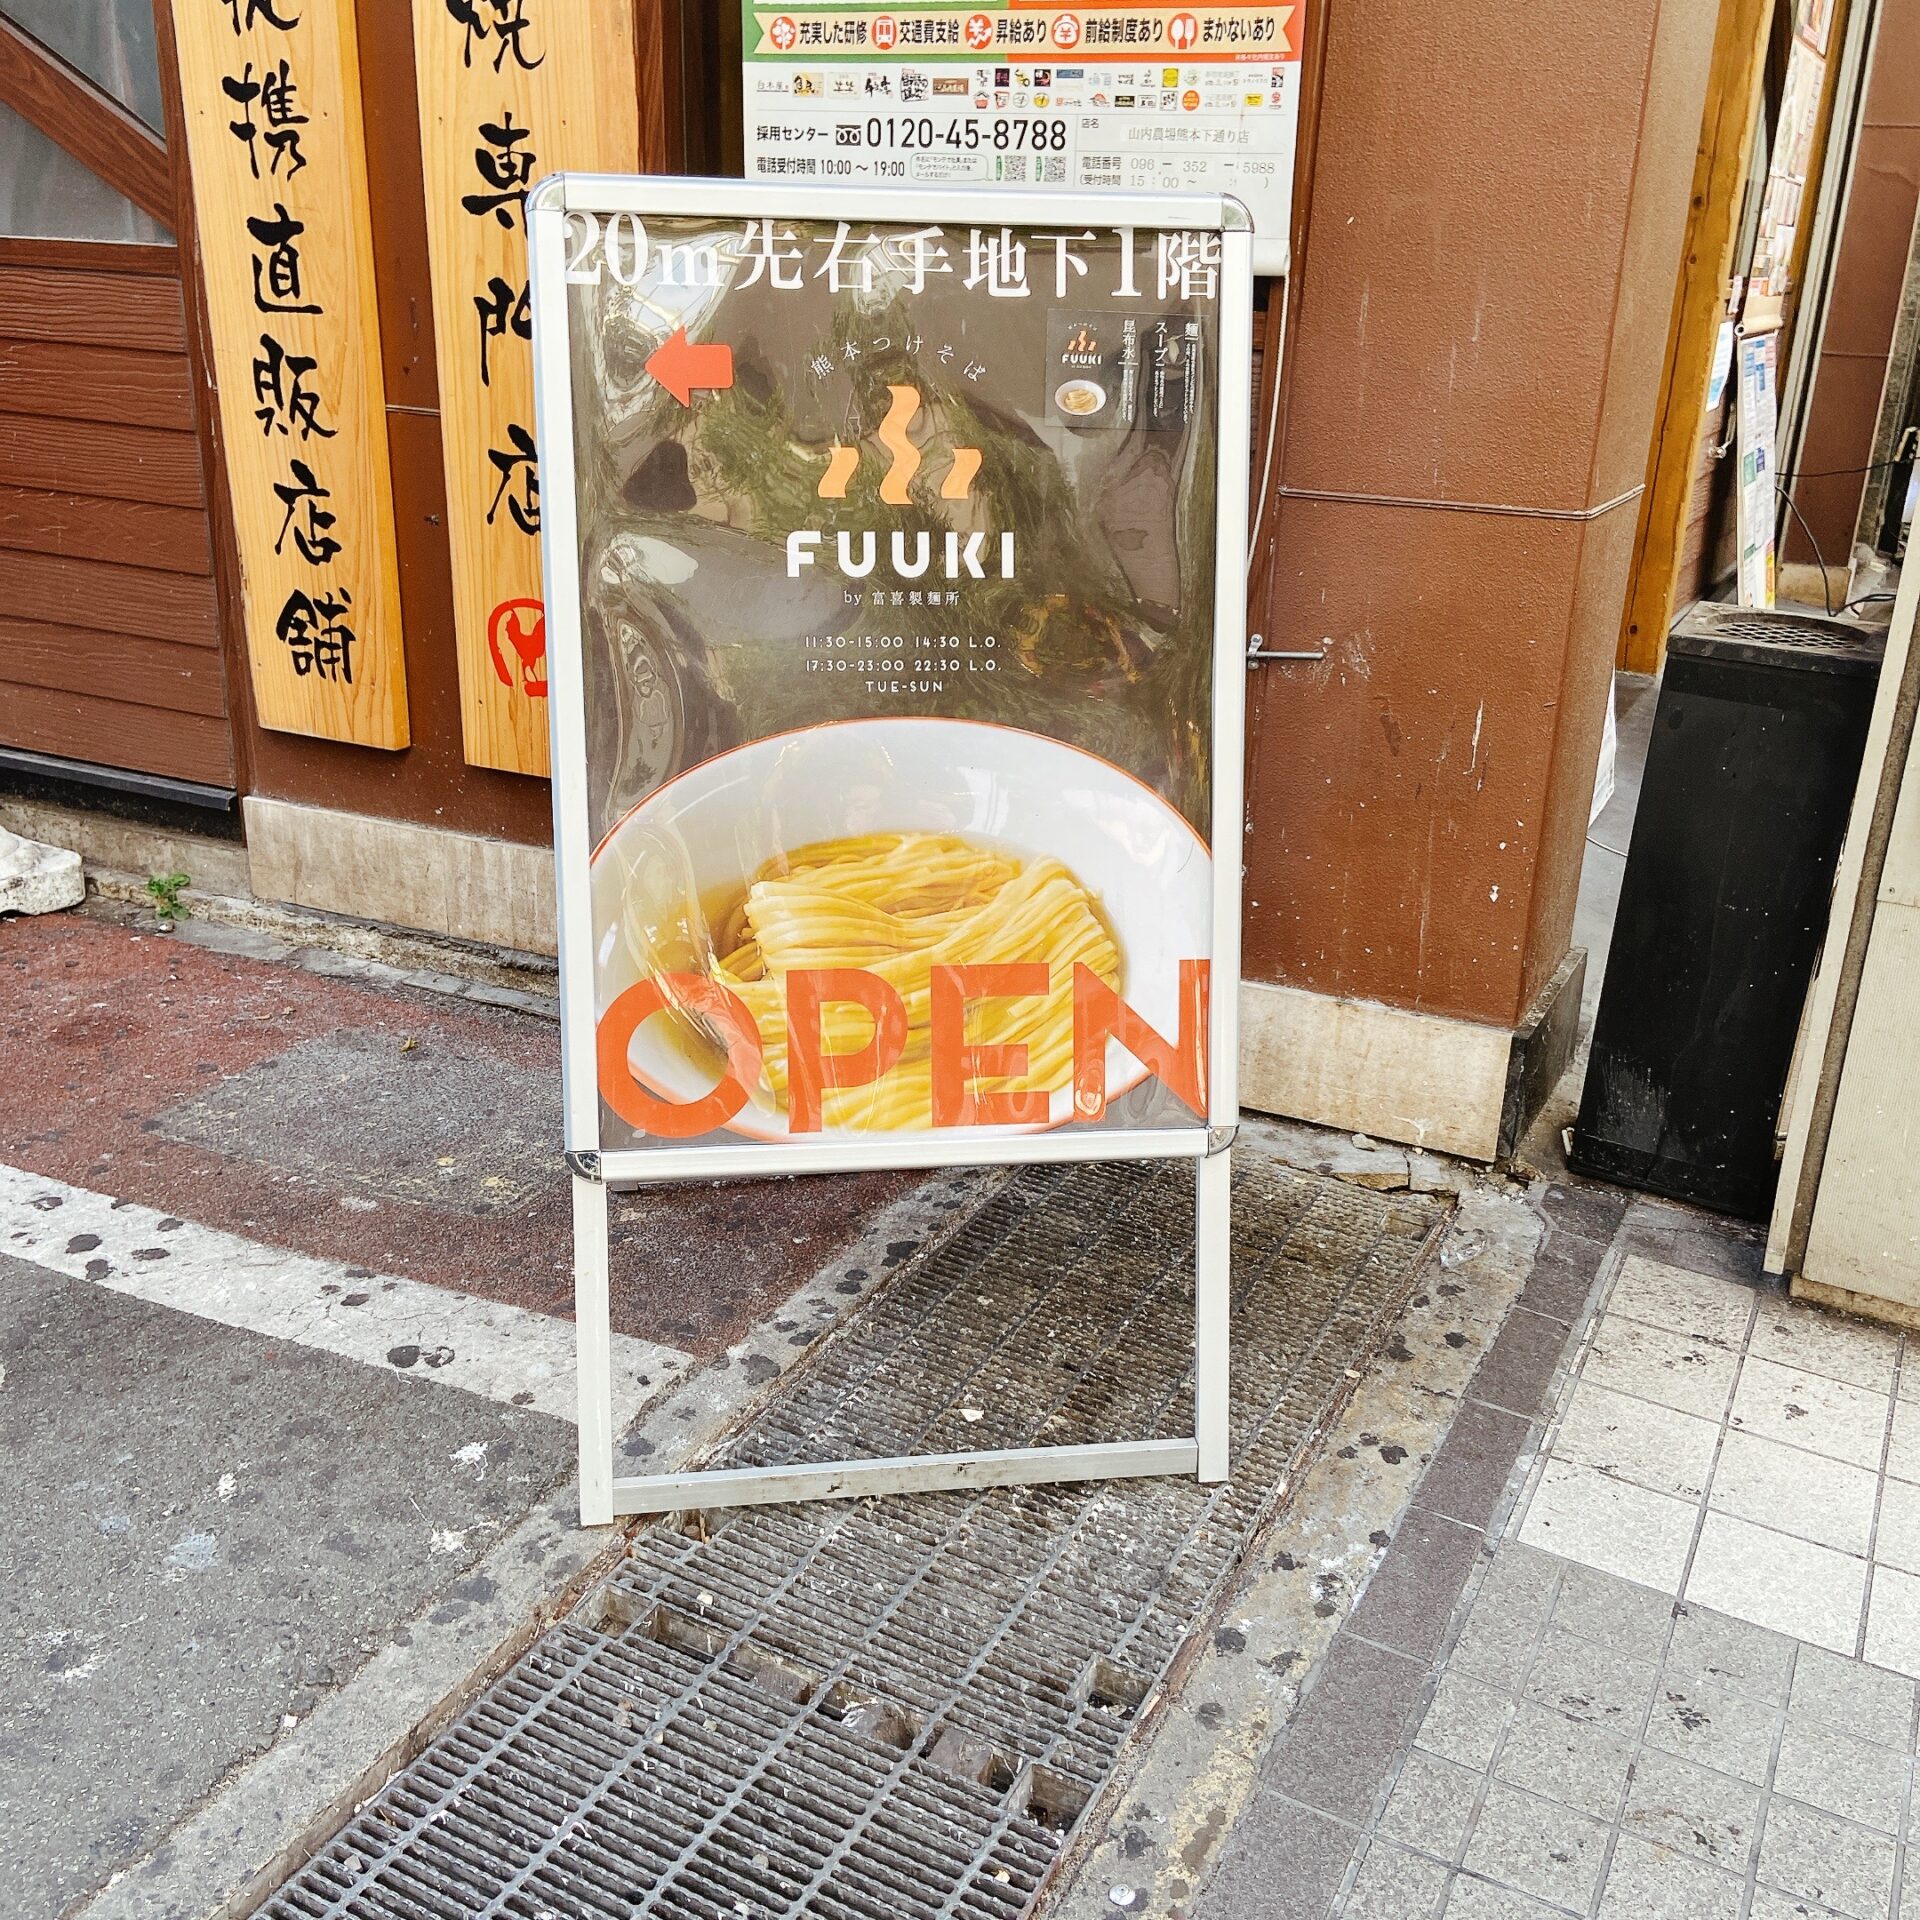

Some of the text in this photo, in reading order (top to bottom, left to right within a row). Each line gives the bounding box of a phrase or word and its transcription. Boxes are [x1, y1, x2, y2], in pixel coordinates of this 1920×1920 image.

[799, 16, 1275, 45] 充実した研修 交通費支給 昇給あり 前給制度あり まかないあり
[1081, 118, 1100, 129] 店名
[756, 117, 1067, 151] 採用センター 0120-45-8788
[1128, 128, 1250, 144] 山内農場熊本下通り店
[756, 156, 816, 175] 電話受付時間
[821, 159, 851, 175] 10:00
[874, 160, 905, 177] 19:00
[1082, 156, 1122, 171] 電話番号
[1130, 158, 1155, 171] 096
[1183, 160, 1207, 173] 352
[1242, 162, 1275, 175] 5988
[1122, 319, 1137, 360] 昆布水
[1154, 322, 1169, 363] スープ
[810, 334, 986, 382] 熊本つけそば
[1062, 354, 1102, 365] FUUKI
[785, 530, 1015, 579] FUUKI
[843, 590, 862, 605] by
[804, 636, 1002, 648] 11:30-15:00 14:30 L.O.
[805, 659, 1002, 672] 17:30-23:00 22:30 L.O.
[864, 681, 944, 693] TUE-SUN
[595, 959, 1211, 1138] OPEN
